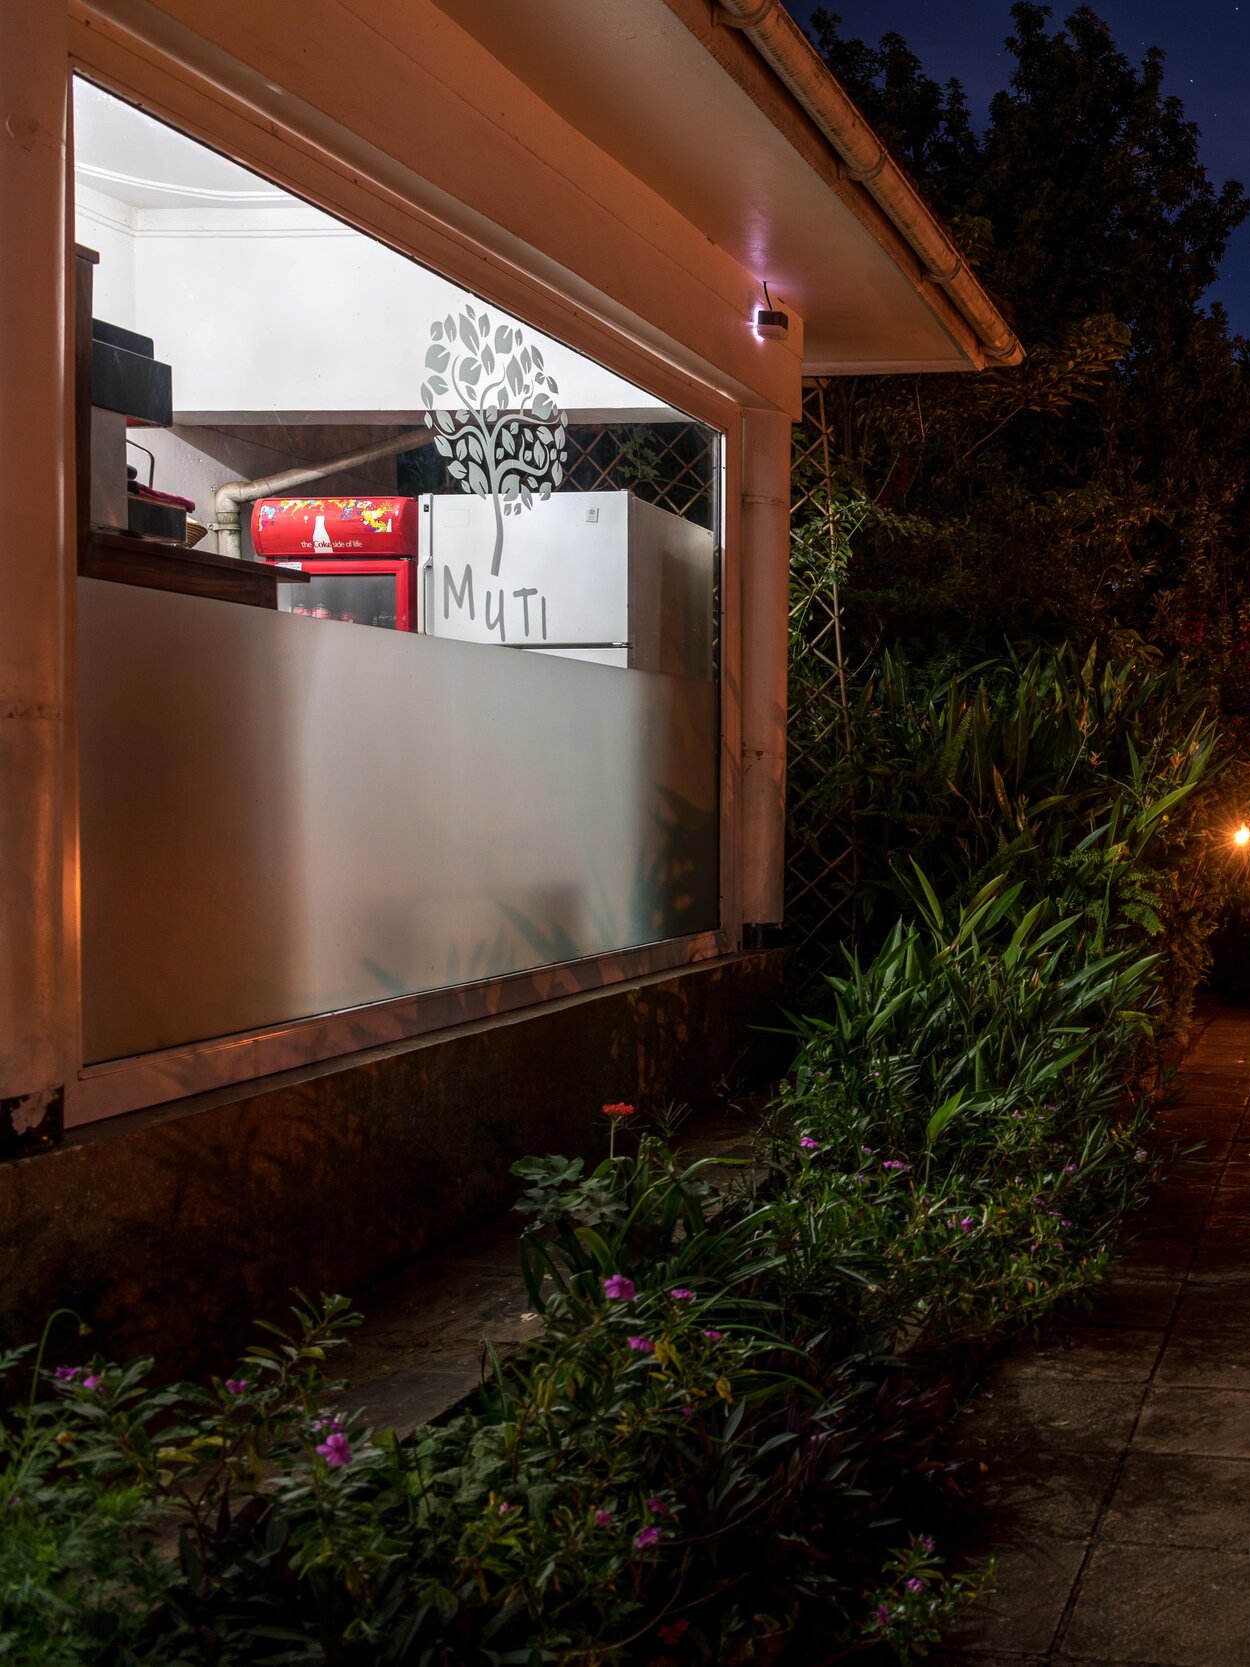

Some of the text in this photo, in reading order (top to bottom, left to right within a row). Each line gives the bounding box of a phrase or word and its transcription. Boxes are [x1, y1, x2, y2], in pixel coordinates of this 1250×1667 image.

[301, 540, 362, 548] the Coke side of life
